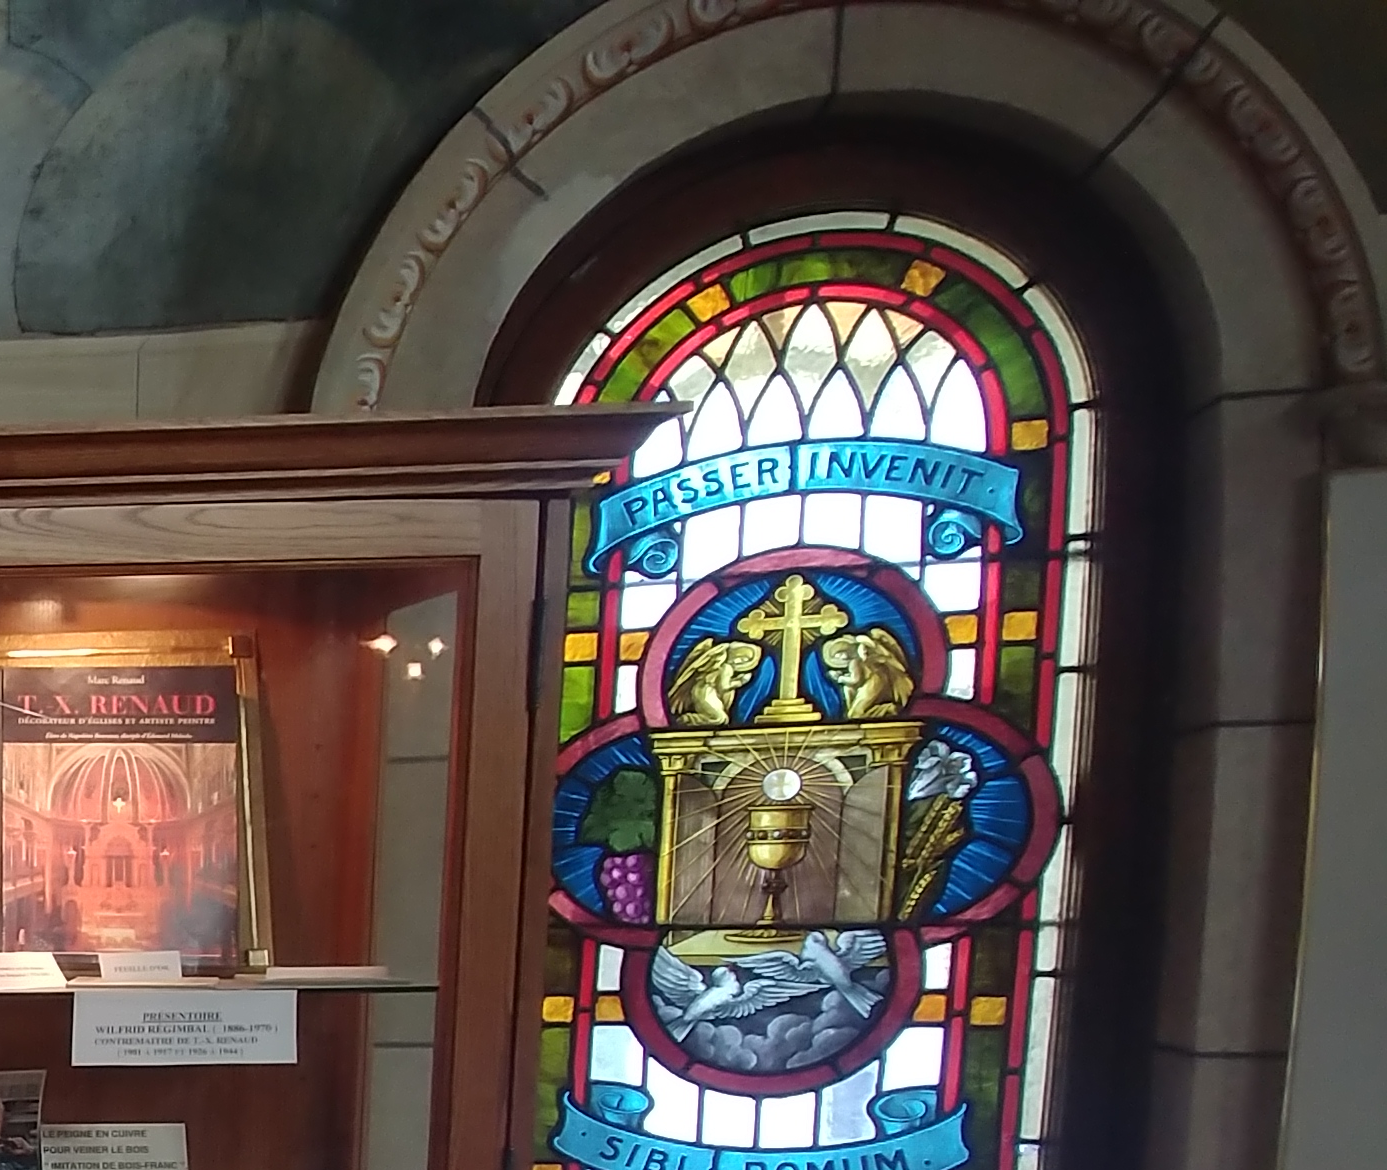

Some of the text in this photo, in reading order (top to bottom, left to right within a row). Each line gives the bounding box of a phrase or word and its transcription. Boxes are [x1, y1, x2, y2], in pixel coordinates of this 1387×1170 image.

[621, 452, 984, 526] PASSER INVENIT
[87, 675, 145, 684] Marc Renaud
[91, 695, 216, 715] RENAUD
[95, 1025, 145, 1034] WILFRID
[177, 1037, 190, 1045] DE
[42, 1129, 147, 1138] LE PEIGNE EN CUIVRE
[43, 1146, 71, 1154] POUR
[73, 1146, 108, 1154] VEINER
[126, 1145, 149, 1154] BOIS
[51, 1162, 100, 1170] IMITATION
[118, 1161, 177, 1169] BOIS-FRANC
